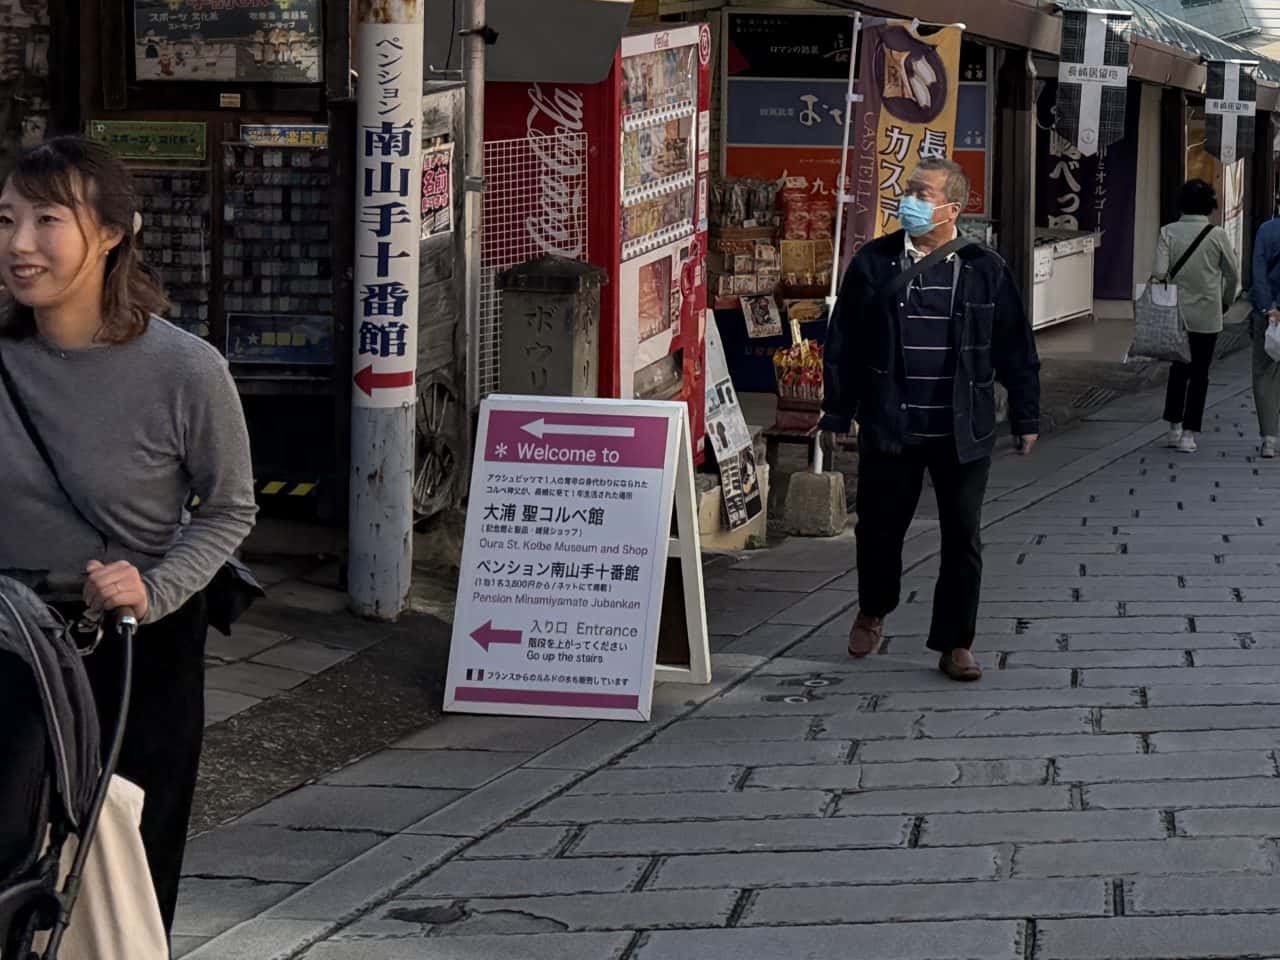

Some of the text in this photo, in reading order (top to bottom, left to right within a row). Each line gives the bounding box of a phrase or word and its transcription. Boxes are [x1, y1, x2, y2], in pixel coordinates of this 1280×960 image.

[517, 442, 620, 463] Welcome to
[483, 503, 605, 527] 大浦 聖コルベ館
[479, 538, 649, 558] Oura St. Kolbe Museum and Shop
[477, 560, 640, 582] ペンション南山手十番館
[472, 592, 641, 610] Pension Minamiyamate Jubankan
[530, 619, 638, 638] 入り口 Entrance
[528, 637, 628, 652] 階段を上がってください
[526, 650, 603, 664] Go up the stairs
